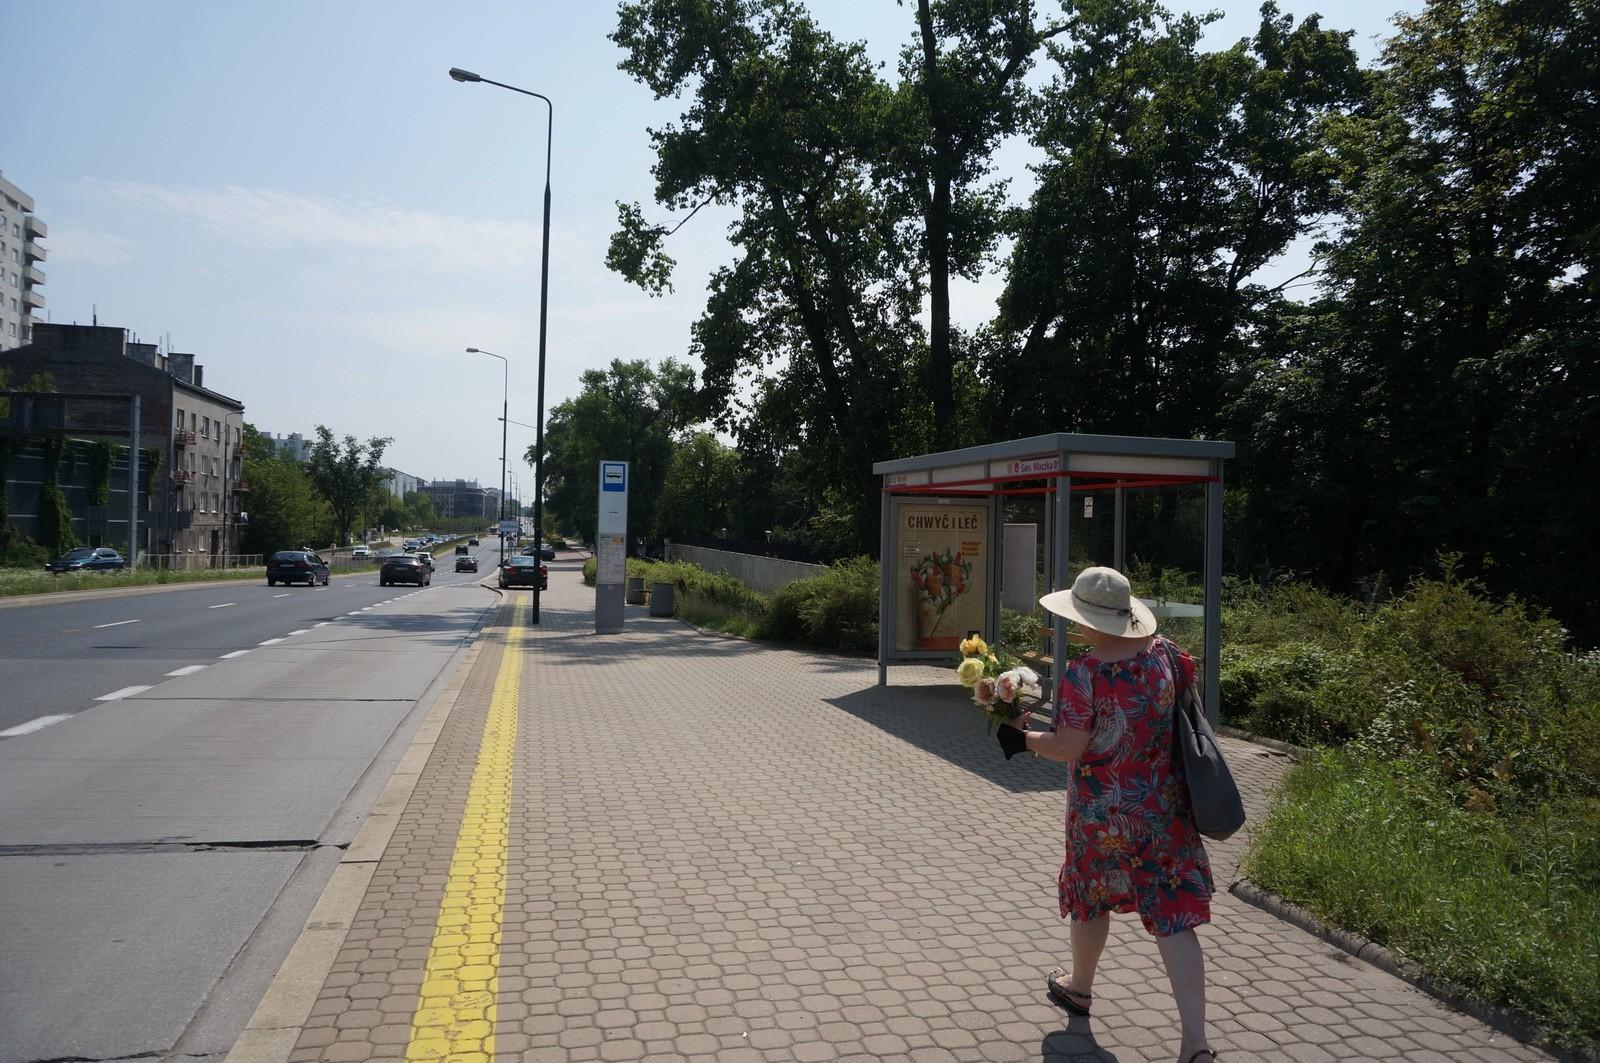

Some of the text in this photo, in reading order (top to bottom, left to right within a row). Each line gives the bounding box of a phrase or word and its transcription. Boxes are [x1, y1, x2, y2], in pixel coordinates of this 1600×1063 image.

[1021, 463, 1032, 473] Gen.
[1033, 461, 1053, 471] Maczka
[908, 513, 978, 529] CHWYĆ I LEĆ
